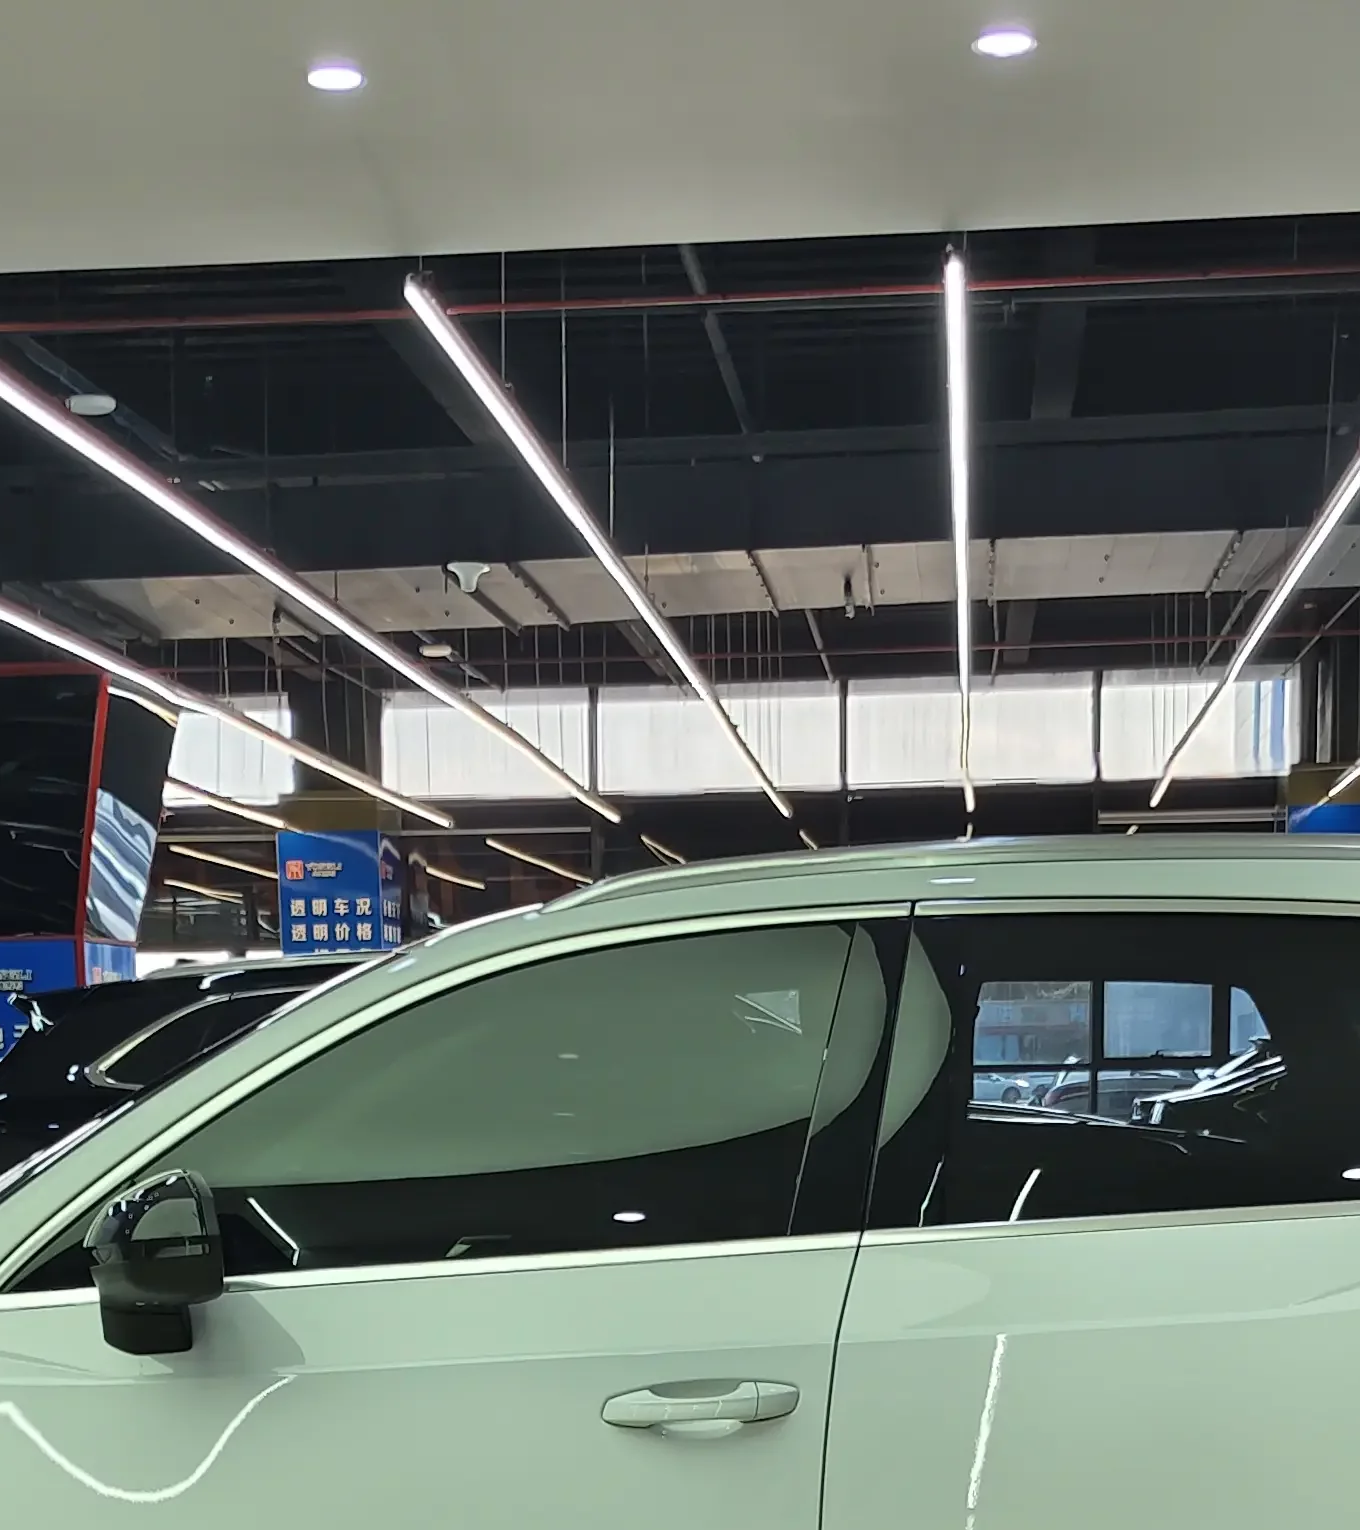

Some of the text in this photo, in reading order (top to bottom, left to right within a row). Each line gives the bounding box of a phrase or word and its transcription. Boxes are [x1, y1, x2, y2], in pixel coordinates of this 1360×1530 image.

[290, 898, 372, 917] 透明车况
[291, 922, 372, 942] 透明价格
